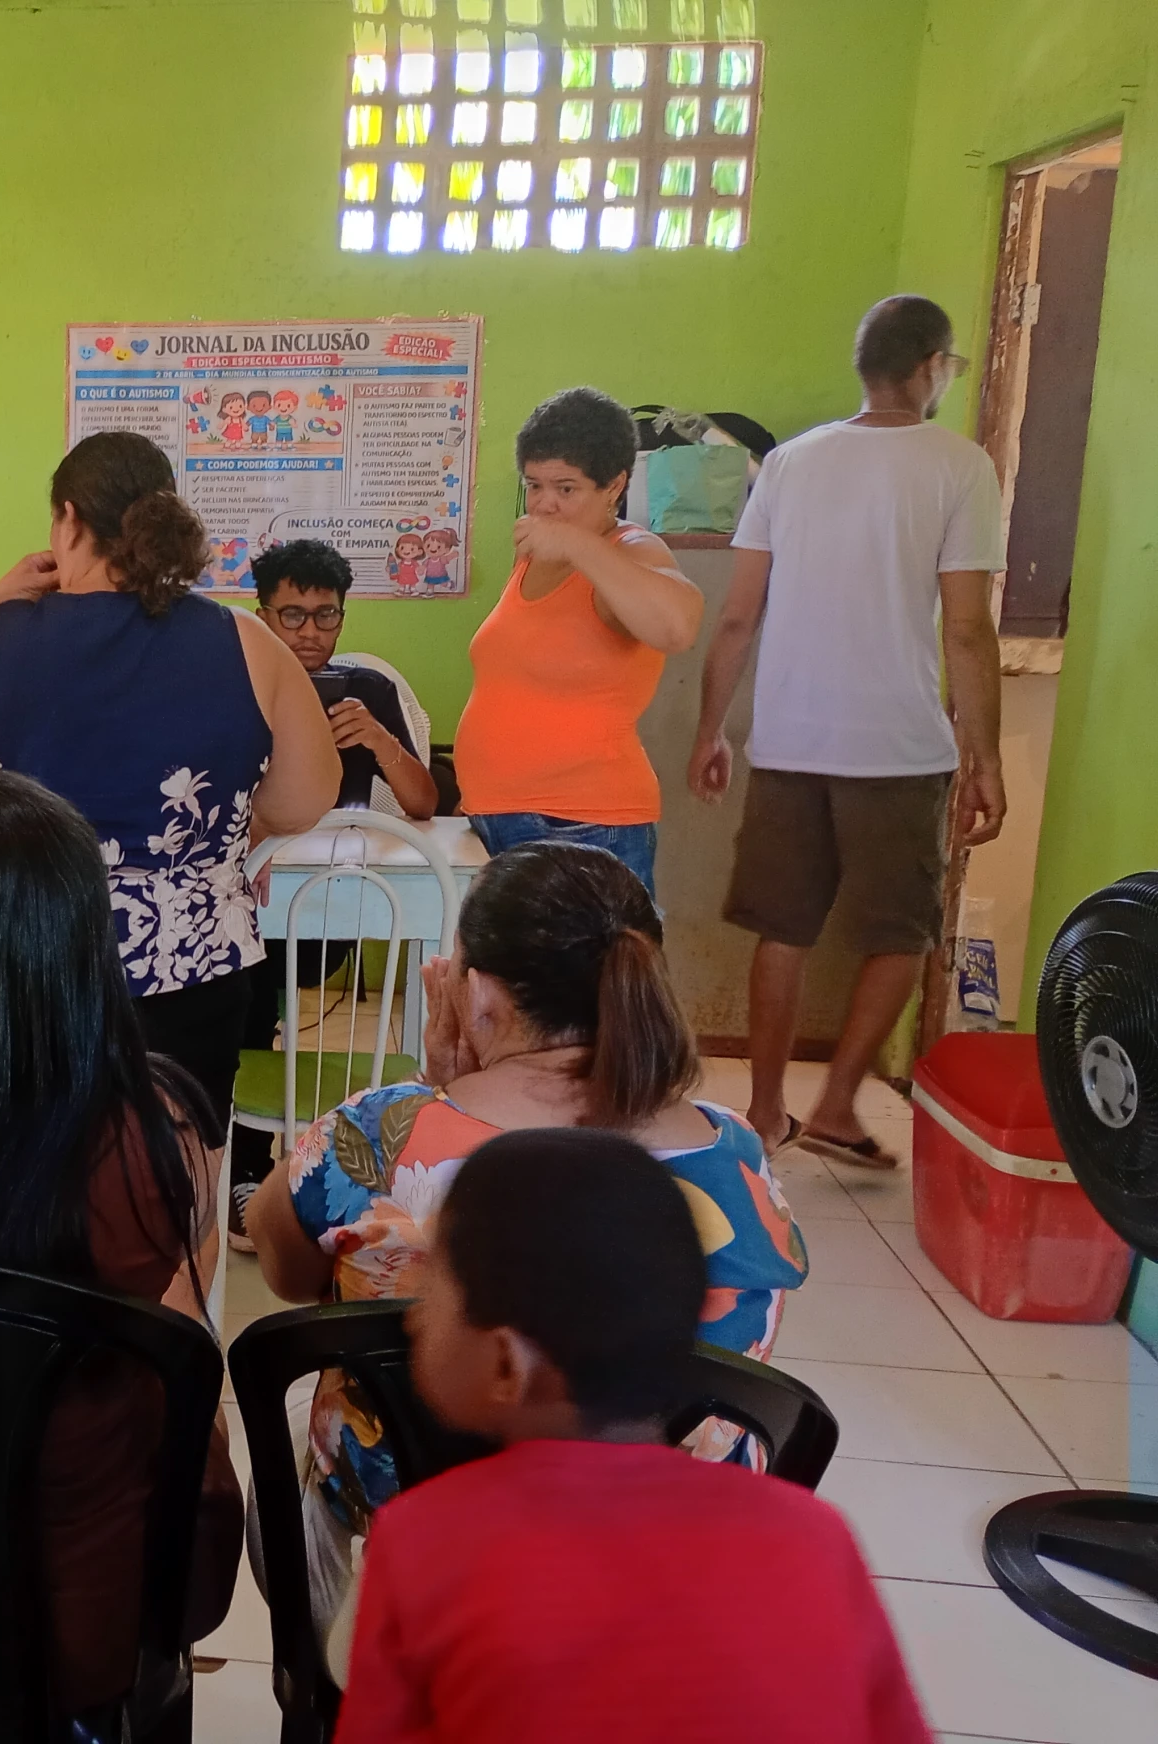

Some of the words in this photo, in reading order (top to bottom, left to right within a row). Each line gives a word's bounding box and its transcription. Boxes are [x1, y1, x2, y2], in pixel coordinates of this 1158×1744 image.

[155, 334, 238, 356] JORNAL
[243, 335, 266, 353] DA
[271, 328, 370, 352] INCLUSÃO
[393, 344, 443, 359] ESPECIAL!
[232, 355, 278, 366] ESPECIAL
[280, 354, 332, 365] AUTISMO
[174, 370, 194, 378] ABRIL
[205, 369, 220, 378] DIA
[222, 369, 255, 378] MUNDIAL
[256, 369, 267, 377] DA
[268, 368, 330, 377] CONSCIENTIZAÇÃO
[345, 368, 379, 376] AUTISMO
[80, 388, 88, 398] O
[89, 388, 108, 399] QUE
[110, 385, 117, 398] É
[119, 388, 127, 398] O
[128, 388, 175, 398] AUTISMO?
[358, 384, 384, 396] VOCÊ
[386, 386, 422, 397] SABIA?
[237, 461, 280, 470] PODEMOS
[287, 517, 344, 529] INCLUSÃO
[347, 519, 394, 530] COMEÇA
[330, 530, 351, 538] COM
[345, 540, 394, 549] EMPATIA.
